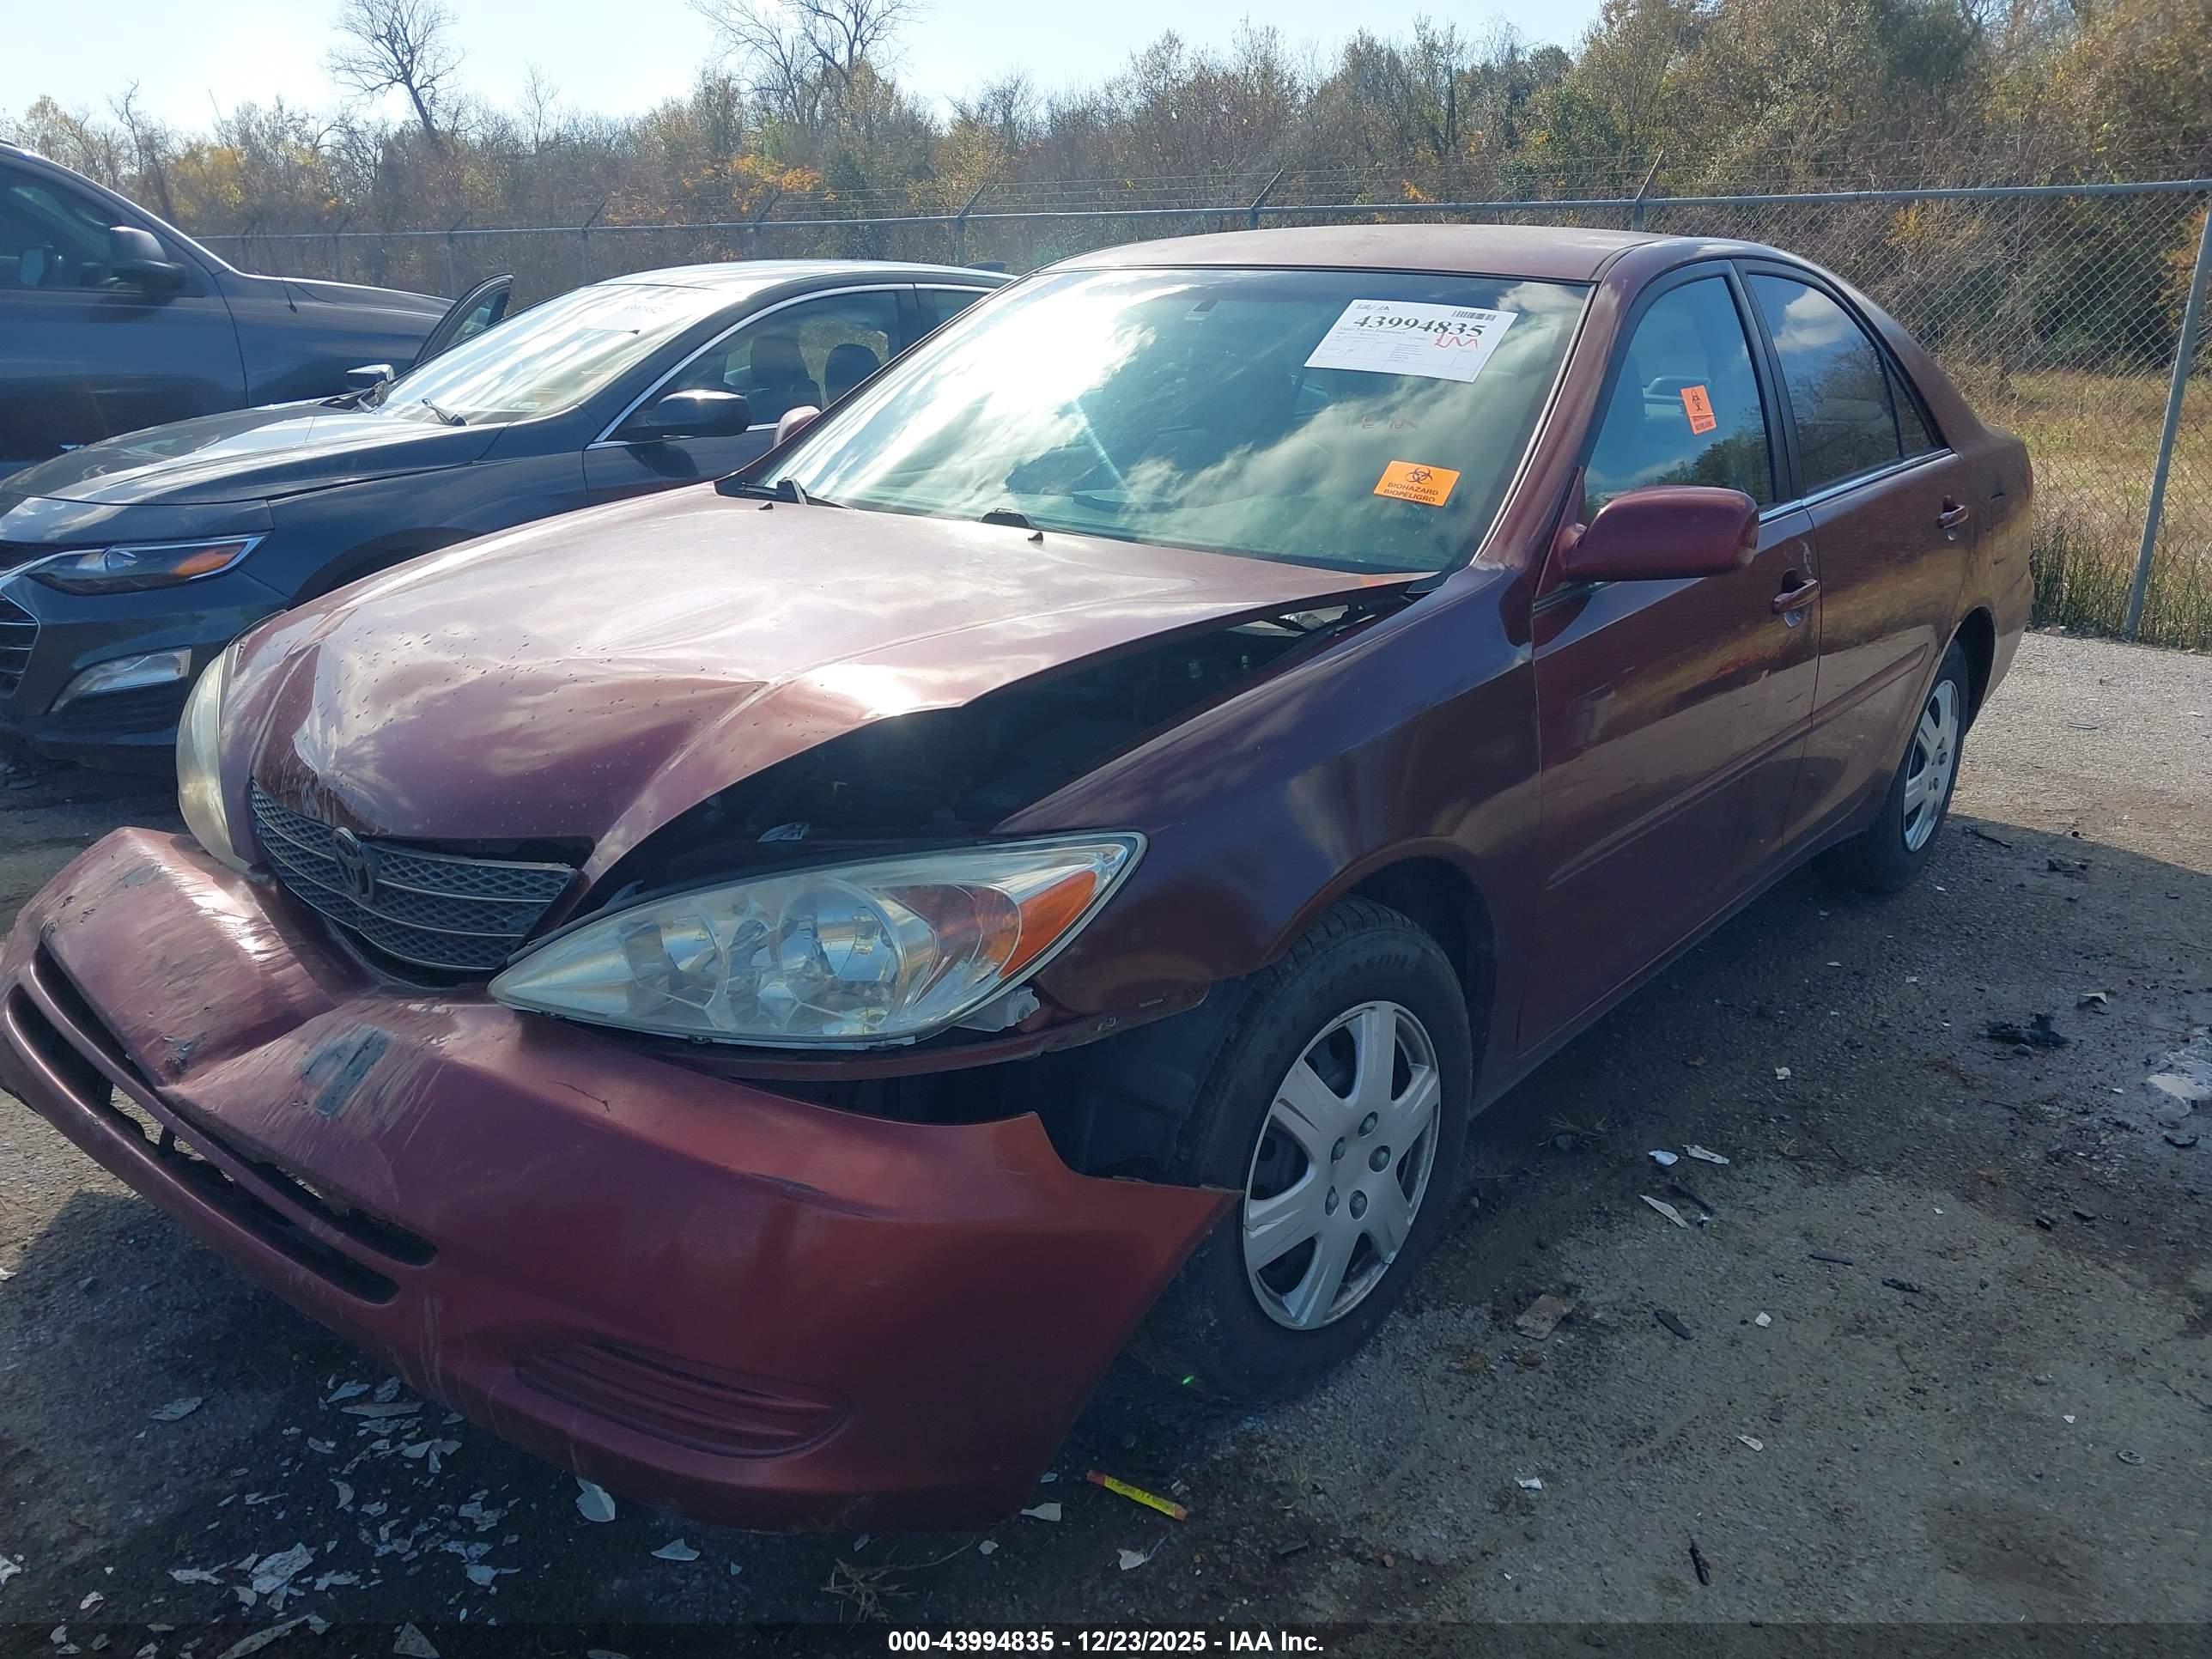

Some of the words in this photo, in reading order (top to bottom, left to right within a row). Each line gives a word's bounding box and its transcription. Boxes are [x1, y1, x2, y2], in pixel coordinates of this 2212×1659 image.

[1353, 315, 1486, 337] 43994835
[1387, 482, 1439, 495] BIOHAZARD
[1383, 489, 1436, 502] BIOPELIGRO
